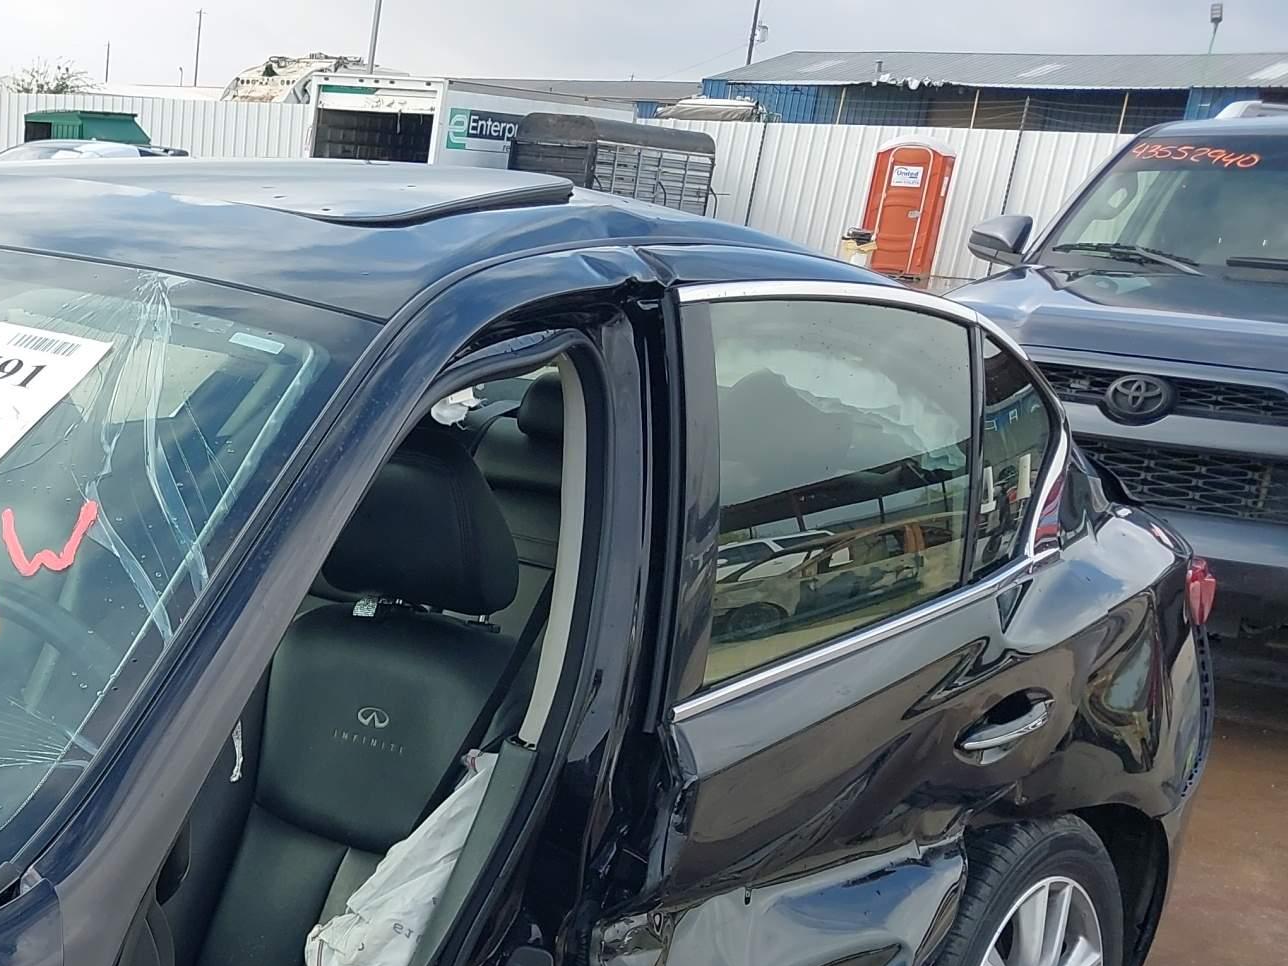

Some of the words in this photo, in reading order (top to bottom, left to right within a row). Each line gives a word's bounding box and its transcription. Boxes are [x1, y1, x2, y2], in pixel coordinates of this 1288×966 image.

[1132, 142, 1261, 168] 43552940
[1, 500, 99, 577] W
[333, 729, 404, 754] INFINITI
